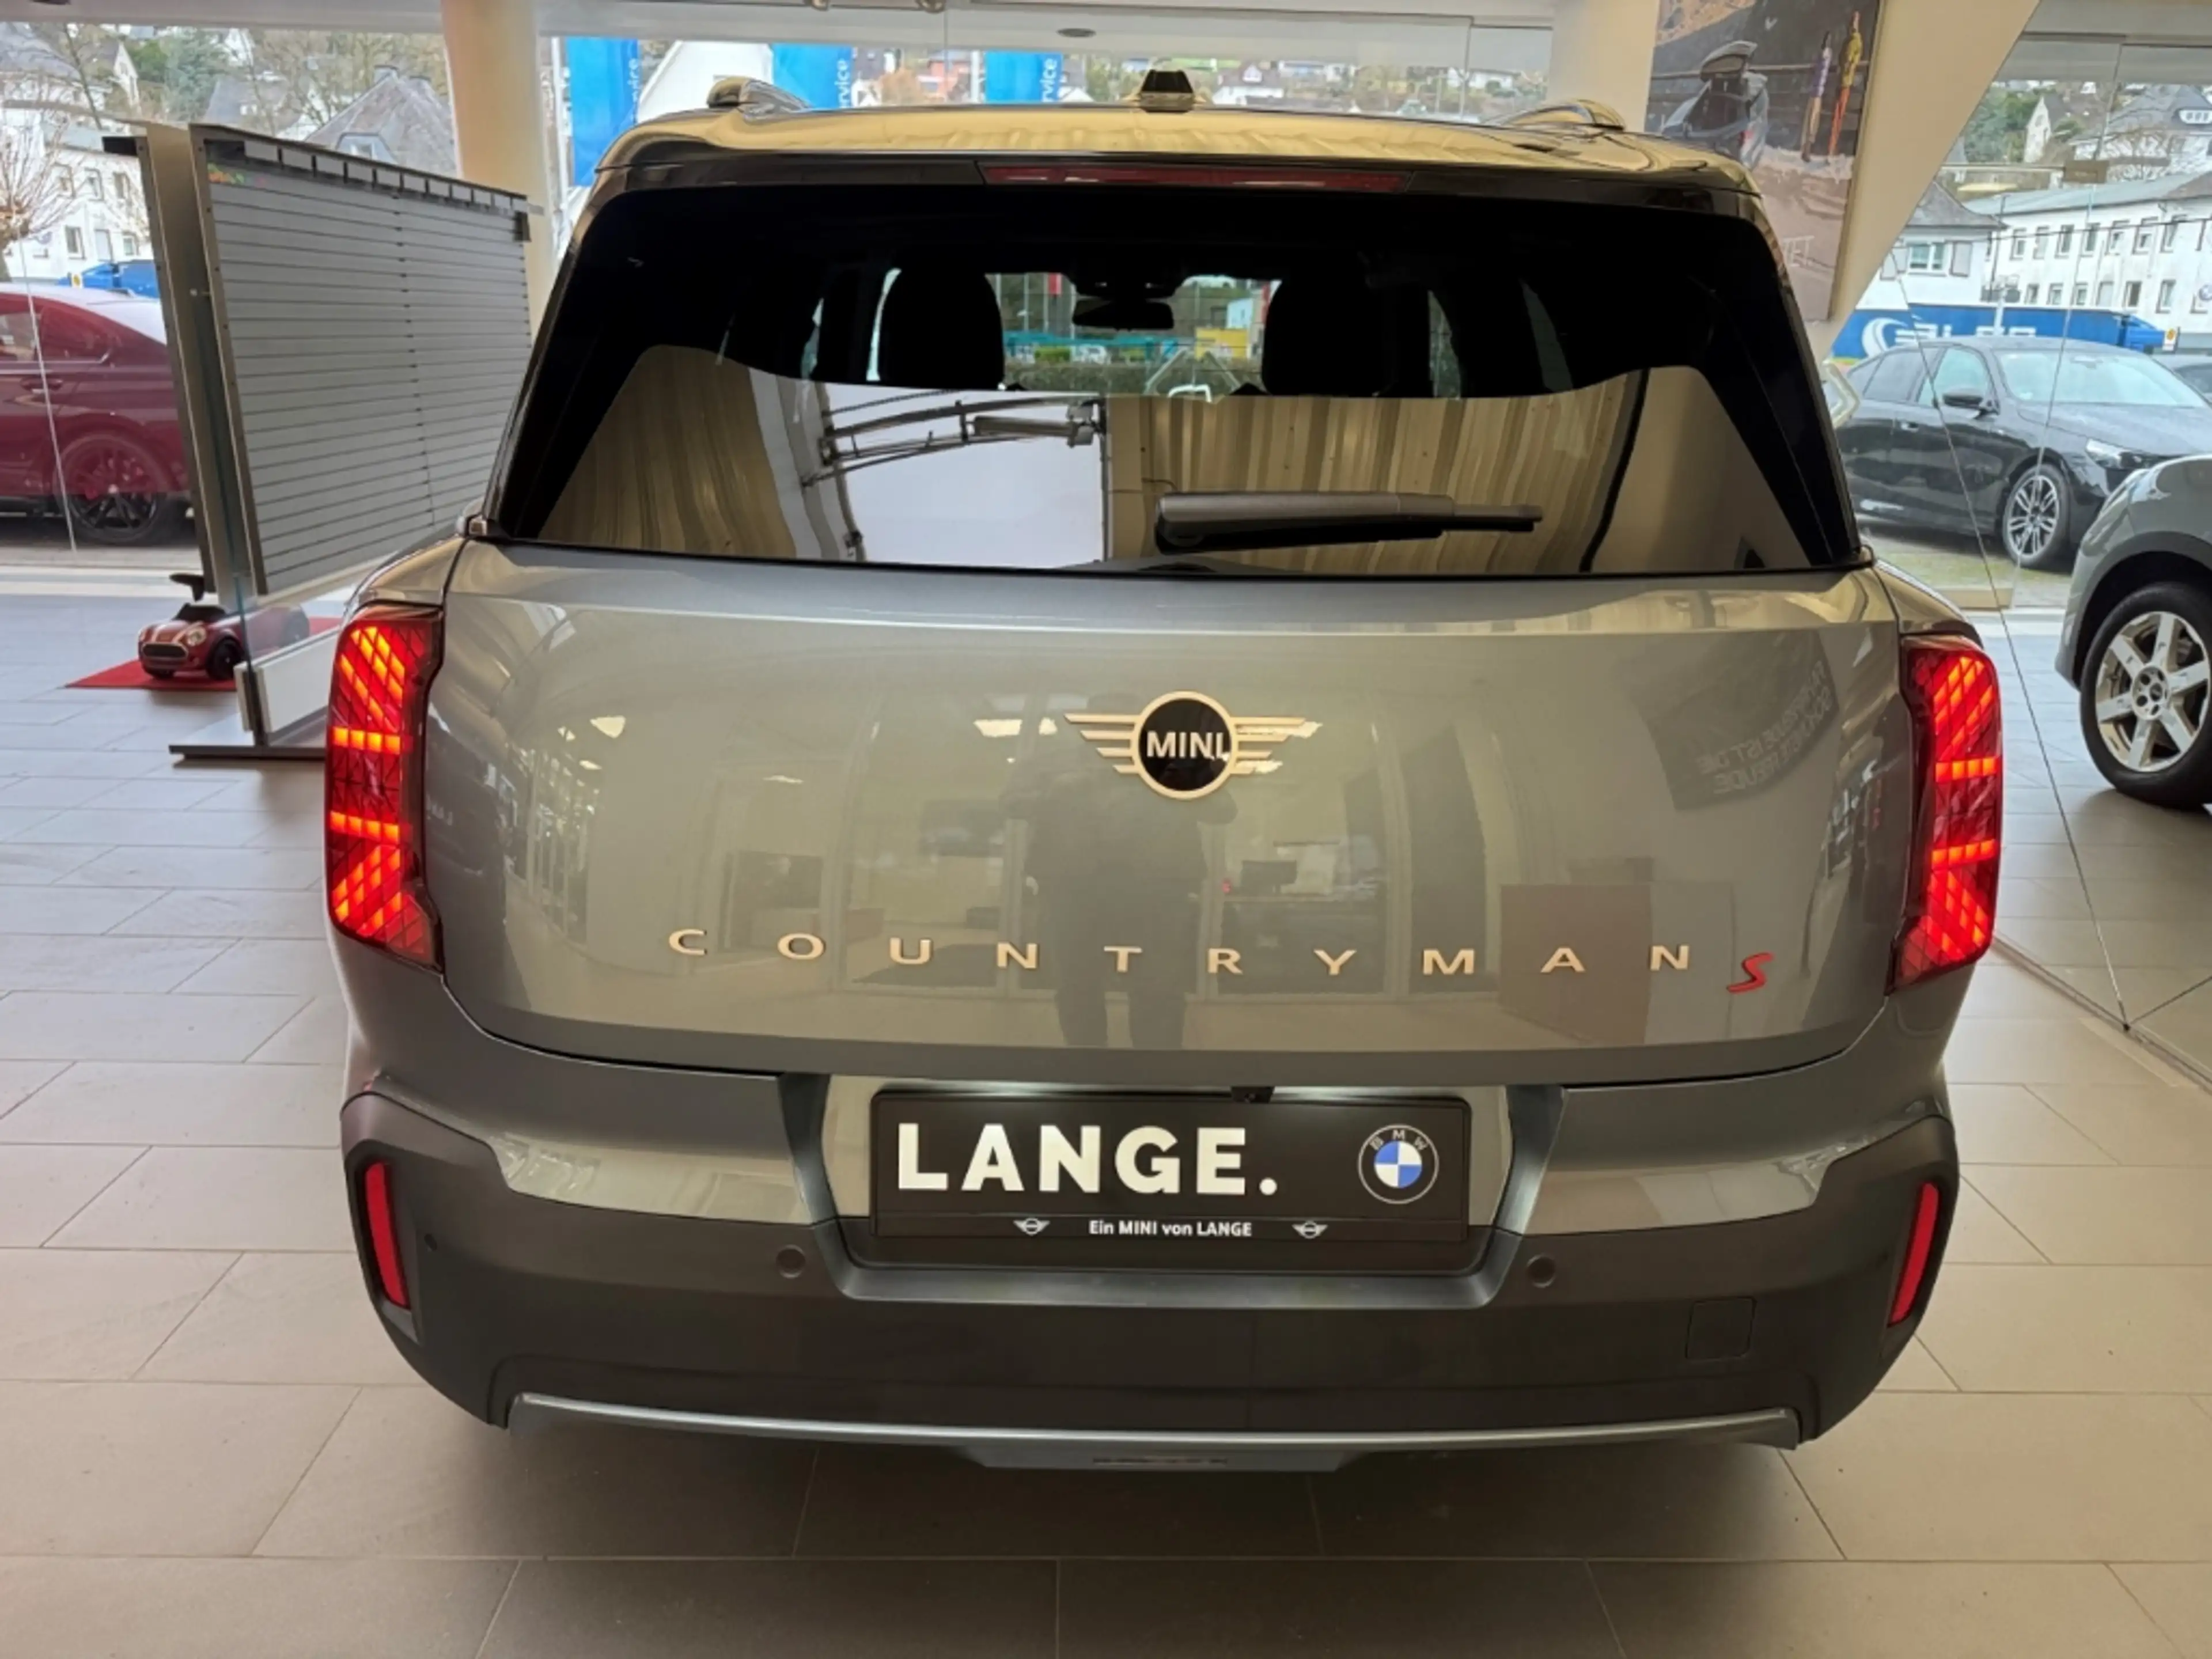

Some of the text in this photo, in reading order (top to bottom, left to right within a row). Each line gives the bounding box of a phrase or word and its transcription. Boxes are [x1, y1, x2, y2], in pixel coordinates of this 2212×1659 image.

[1147, 730, 1224, 759] MINI
[668, 929, 1774, 993] COUNTRYMAN S
[1368, 1128, 1429, 1151] BMW
[898, 1123, 1278, 1196] LANGE.
[1089, 1219, 1252, 1237] Ein MINI von LANGE
